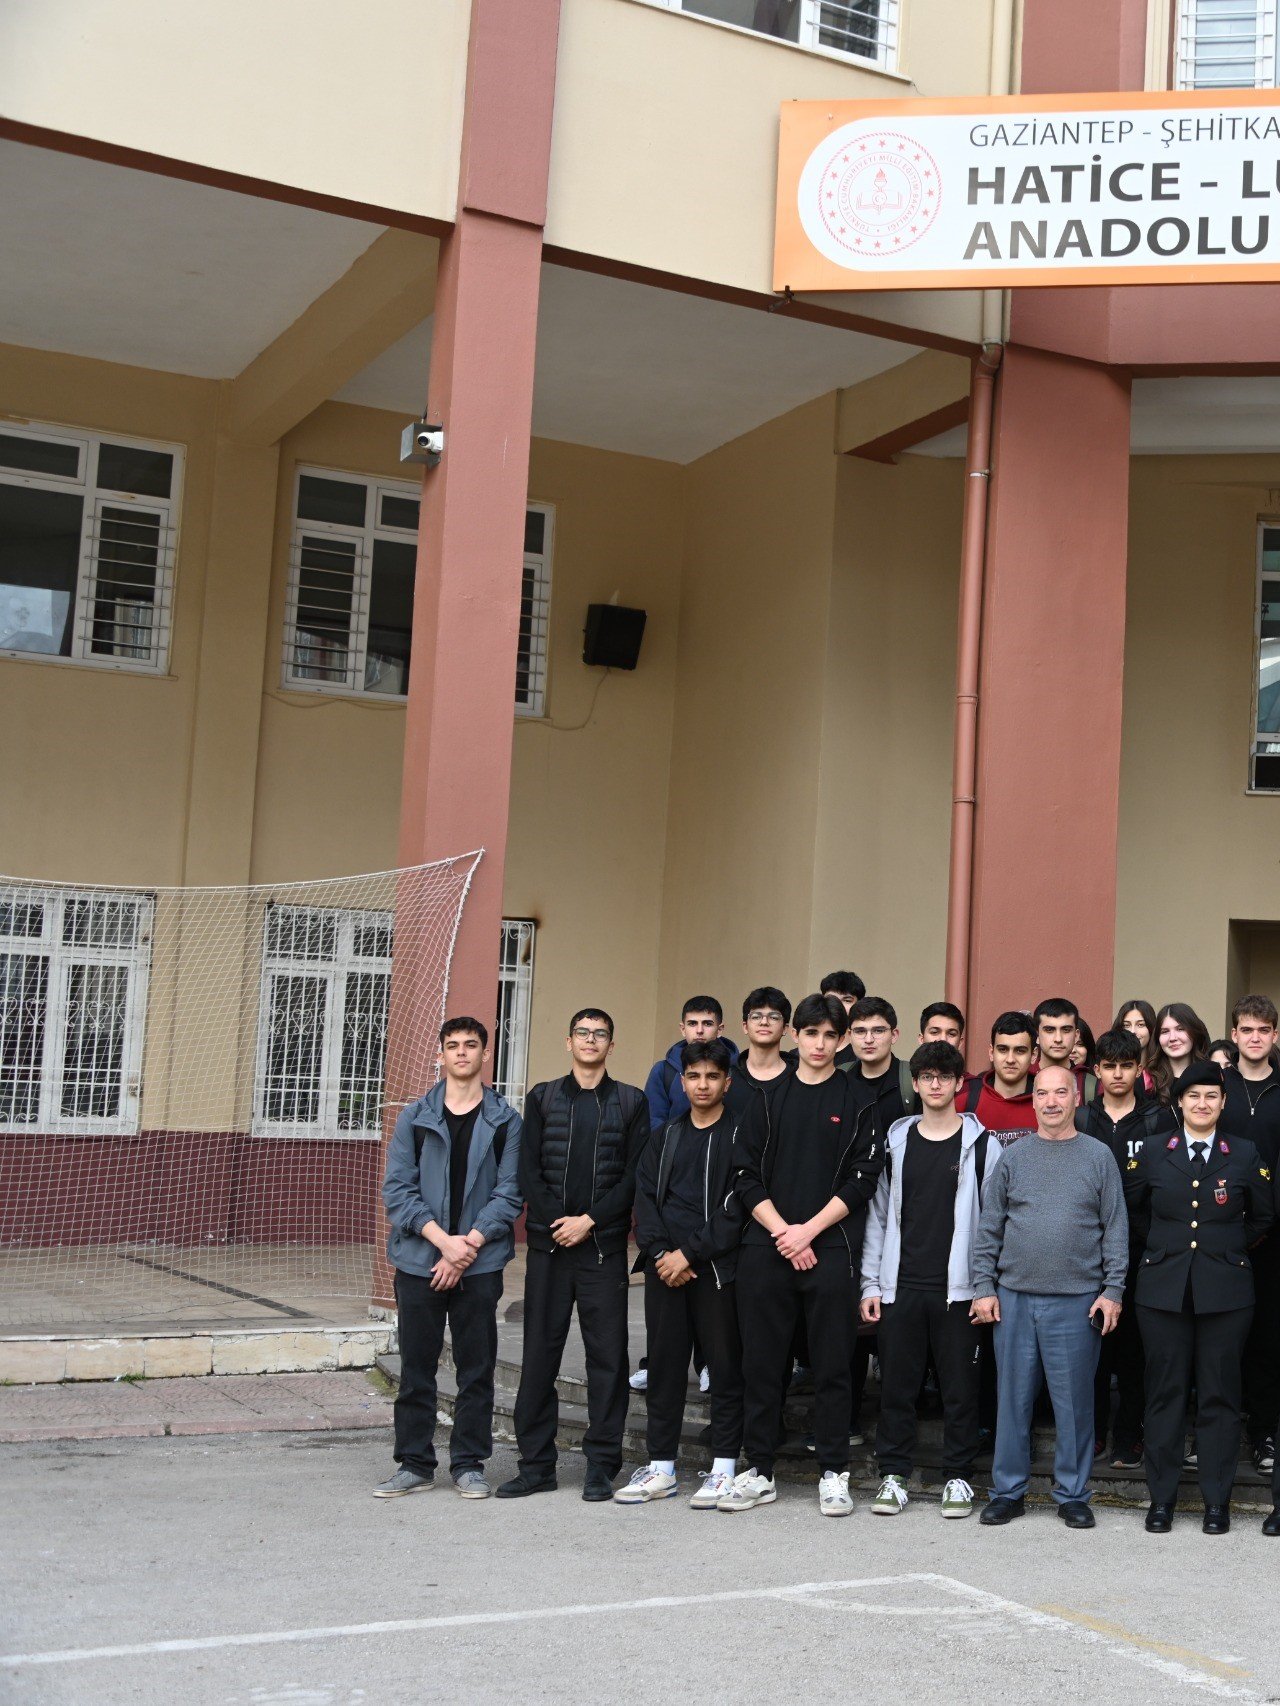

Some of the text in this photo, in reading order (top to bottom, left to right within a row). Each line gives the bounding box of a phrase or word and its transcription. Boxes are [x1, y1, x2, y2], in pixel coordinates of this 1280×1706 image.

[969, 116, 1134, 147] GAZİANTEP
[967, 154, 1181, 205] HATİCE
[962, 215, 1270, 260] ANADOLU
